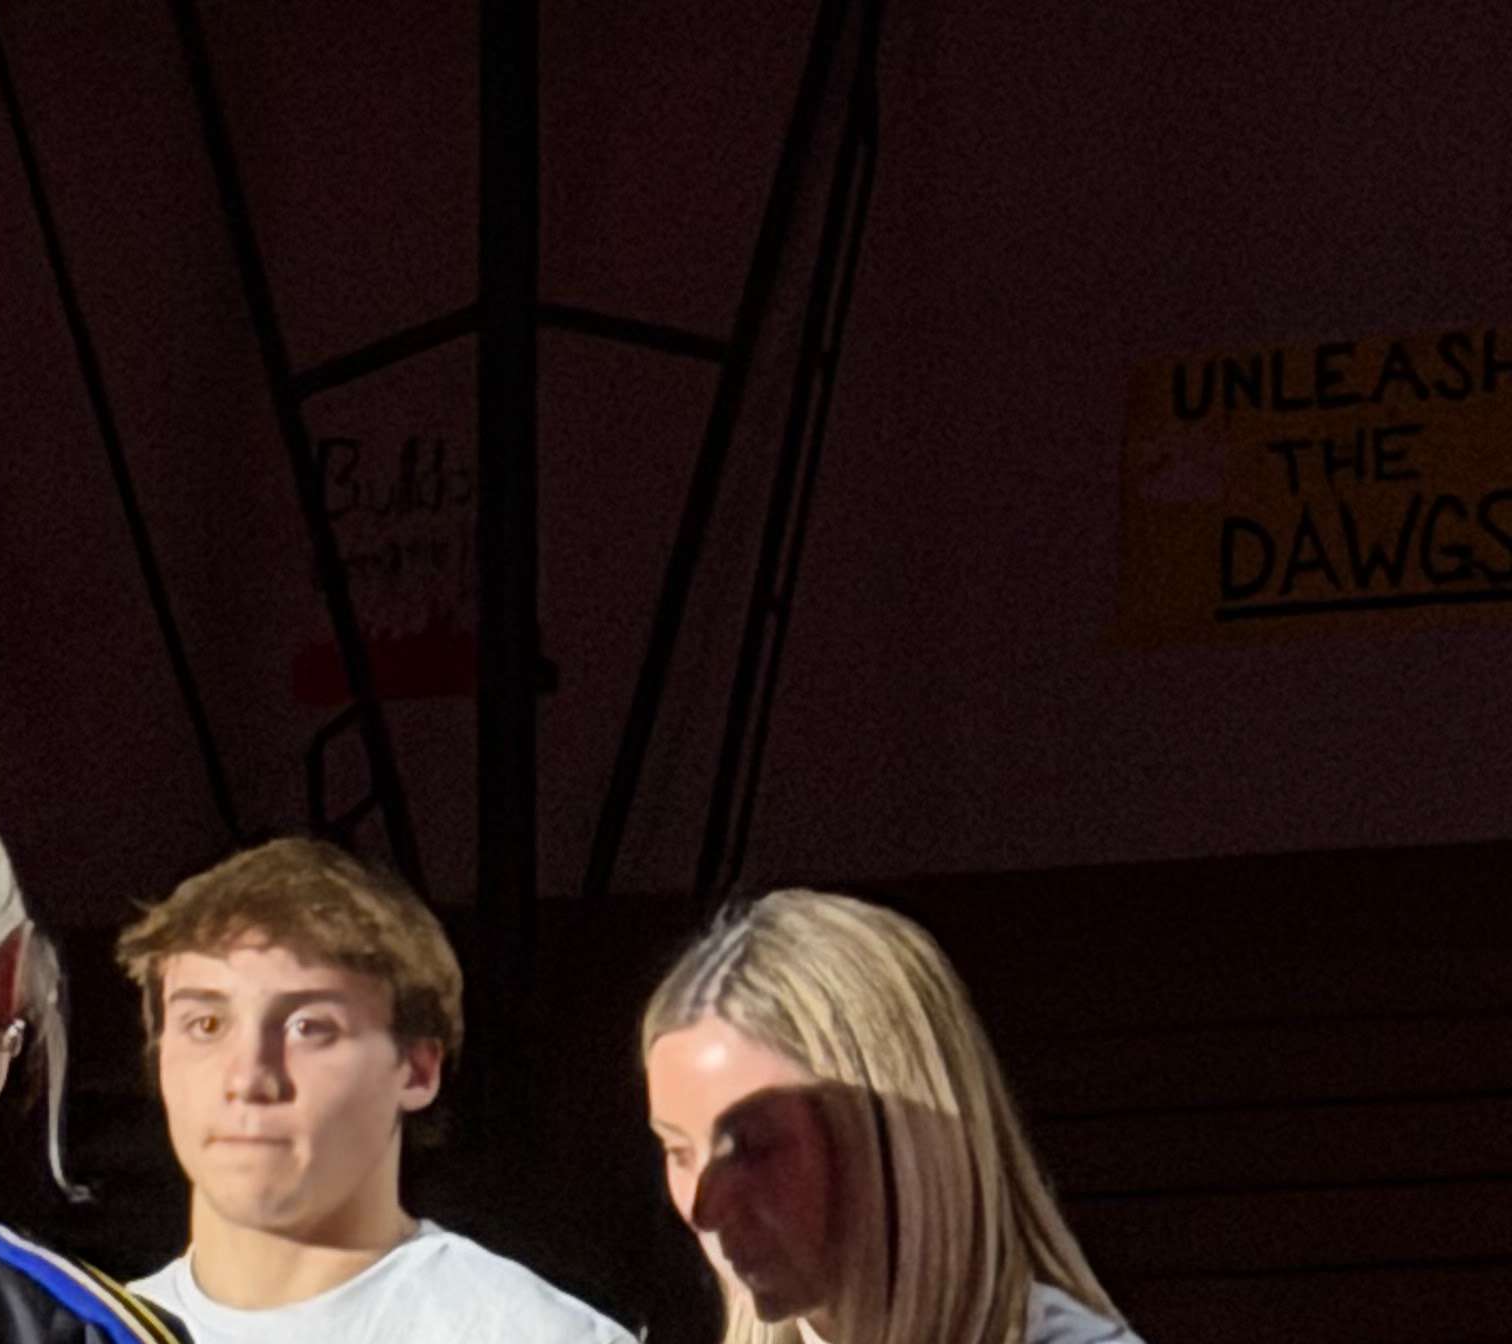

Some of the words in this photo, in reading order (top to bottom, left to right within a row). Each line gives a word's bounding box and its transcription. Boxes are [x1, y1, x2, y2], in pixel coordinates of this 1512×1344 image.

[1172, 330, 1512, 423] UNLEASH
[1267, 423, 1425, 496] THE
[1221, 489, 1512, 600] DAWGS
